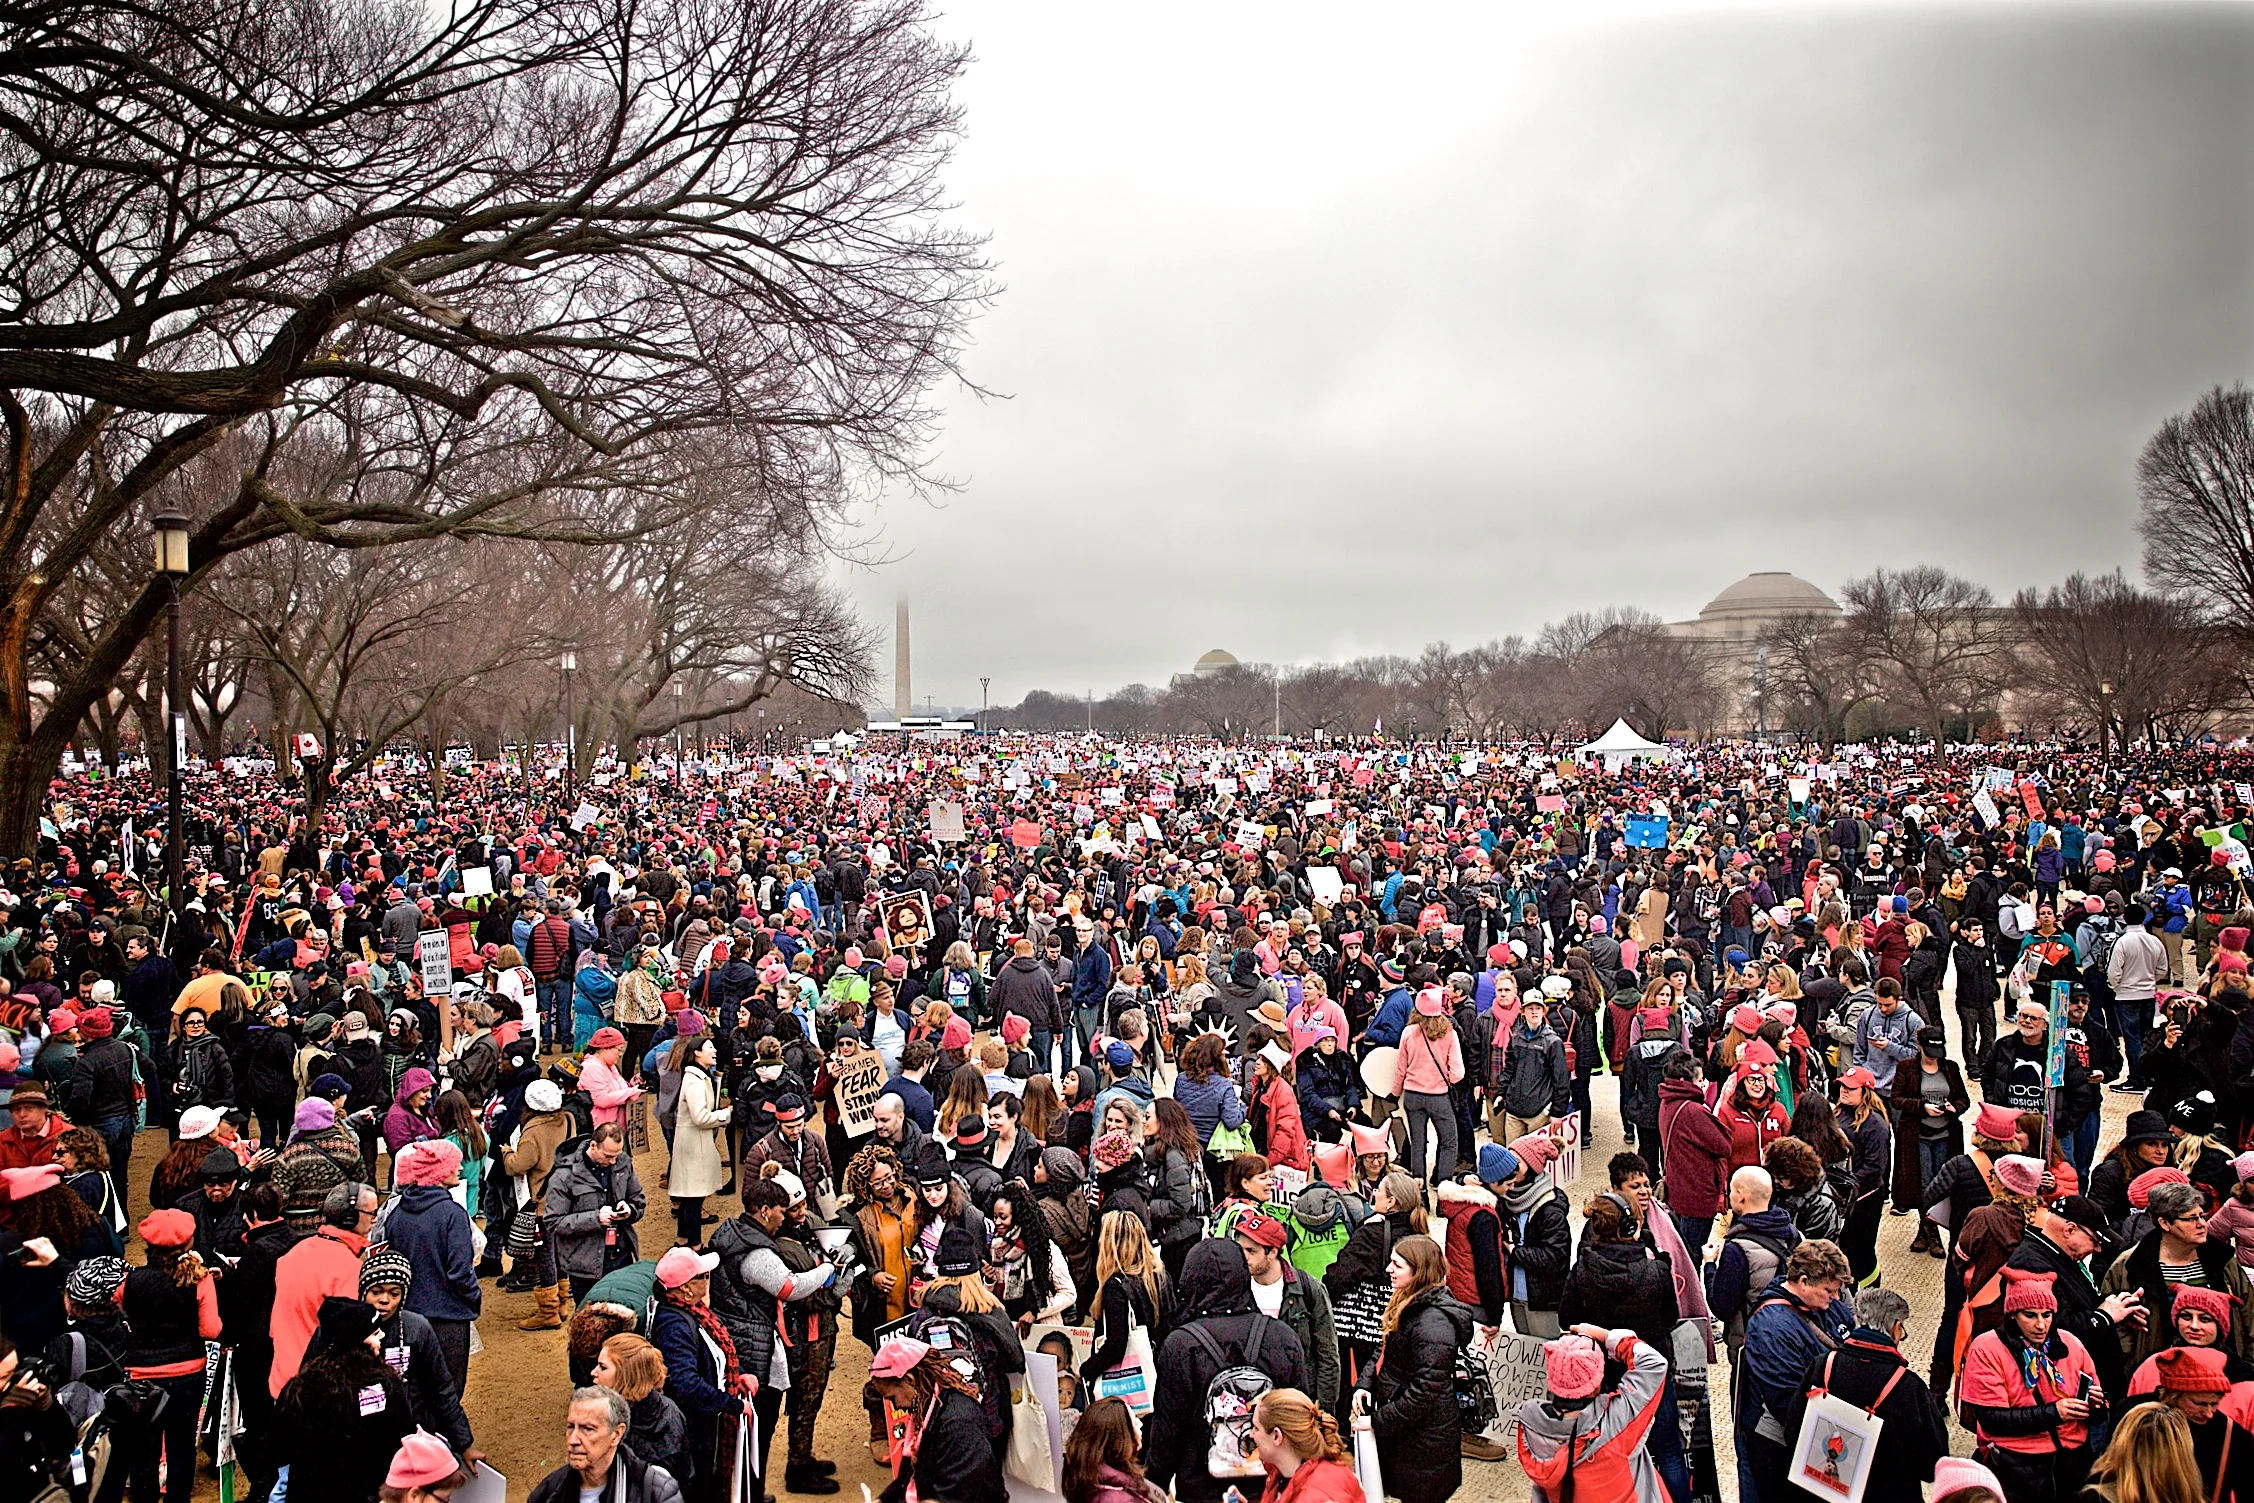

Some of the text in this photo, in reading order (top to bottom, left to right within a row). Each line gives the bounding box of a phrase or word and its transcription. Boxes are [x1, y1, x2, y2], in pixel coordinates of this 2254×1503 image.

[263, 902, 279, 920] 83
[860, 1056, 876, 1071] MEN
[841, 1065, 881, 1099] FEAR
[1308, 1229, 1338, 1245] LOVE
[1489, 1359, 1547, 1388] POWER
